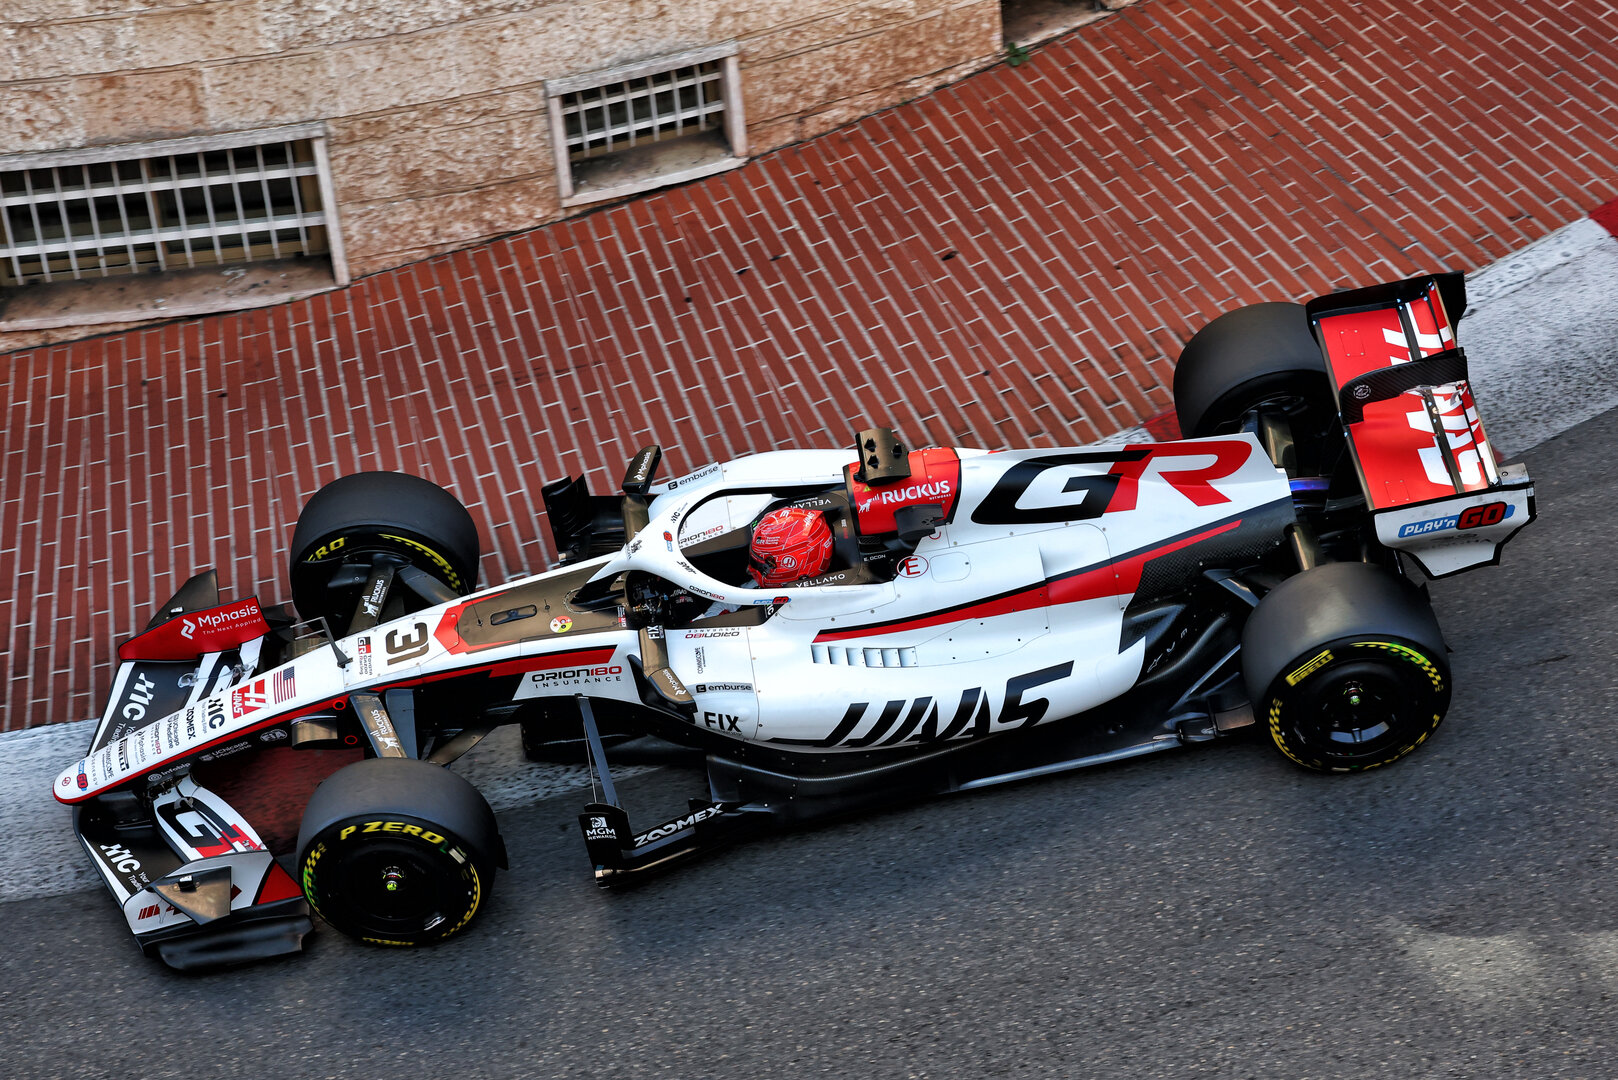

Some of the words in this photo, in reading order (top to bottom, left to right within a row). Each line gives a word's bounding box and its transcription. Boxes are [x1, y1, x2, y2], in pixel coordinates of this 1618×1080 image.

[679, 465, 719, 486] emburse
[970, 439, 1253, 525] GR
[881, 480, 951, 505] RUCKUS
[790, 498, 831, 509] VELLAM
[1459, 504, 1506, 530] GO
[679, 525, 724, 545] RION180
[308, 537, 345, 562] RO
[905, 557, 921, 575] E
[370, 579, 385, 603] RUCKUS
[197, 605, 259, 628] Mphasis
[234, 617, 262, 628] Applied
[647, 625, 660, 639] FIX
[685, 631, 740, 639] ORION180
[358, 638, 366, 655] GR
[531, 666, 622, 683] ORION180
[534, 676, 622, 689] INSURANCE
[663, 669, 680, 690] Mphasis
[186, 706, 196, 740] ZOOMEX
[370, 709, 388, 735] RUCKUS
[703, 711, 742, 733] FIX
[260, 729, 287, 741] FIA
[340, 825, 357, 840] P
[362, 821, 447, 844] ZERO
[585, 827, 616, 837] MGM
[633, 803, 724, 847] ZOOMEX
